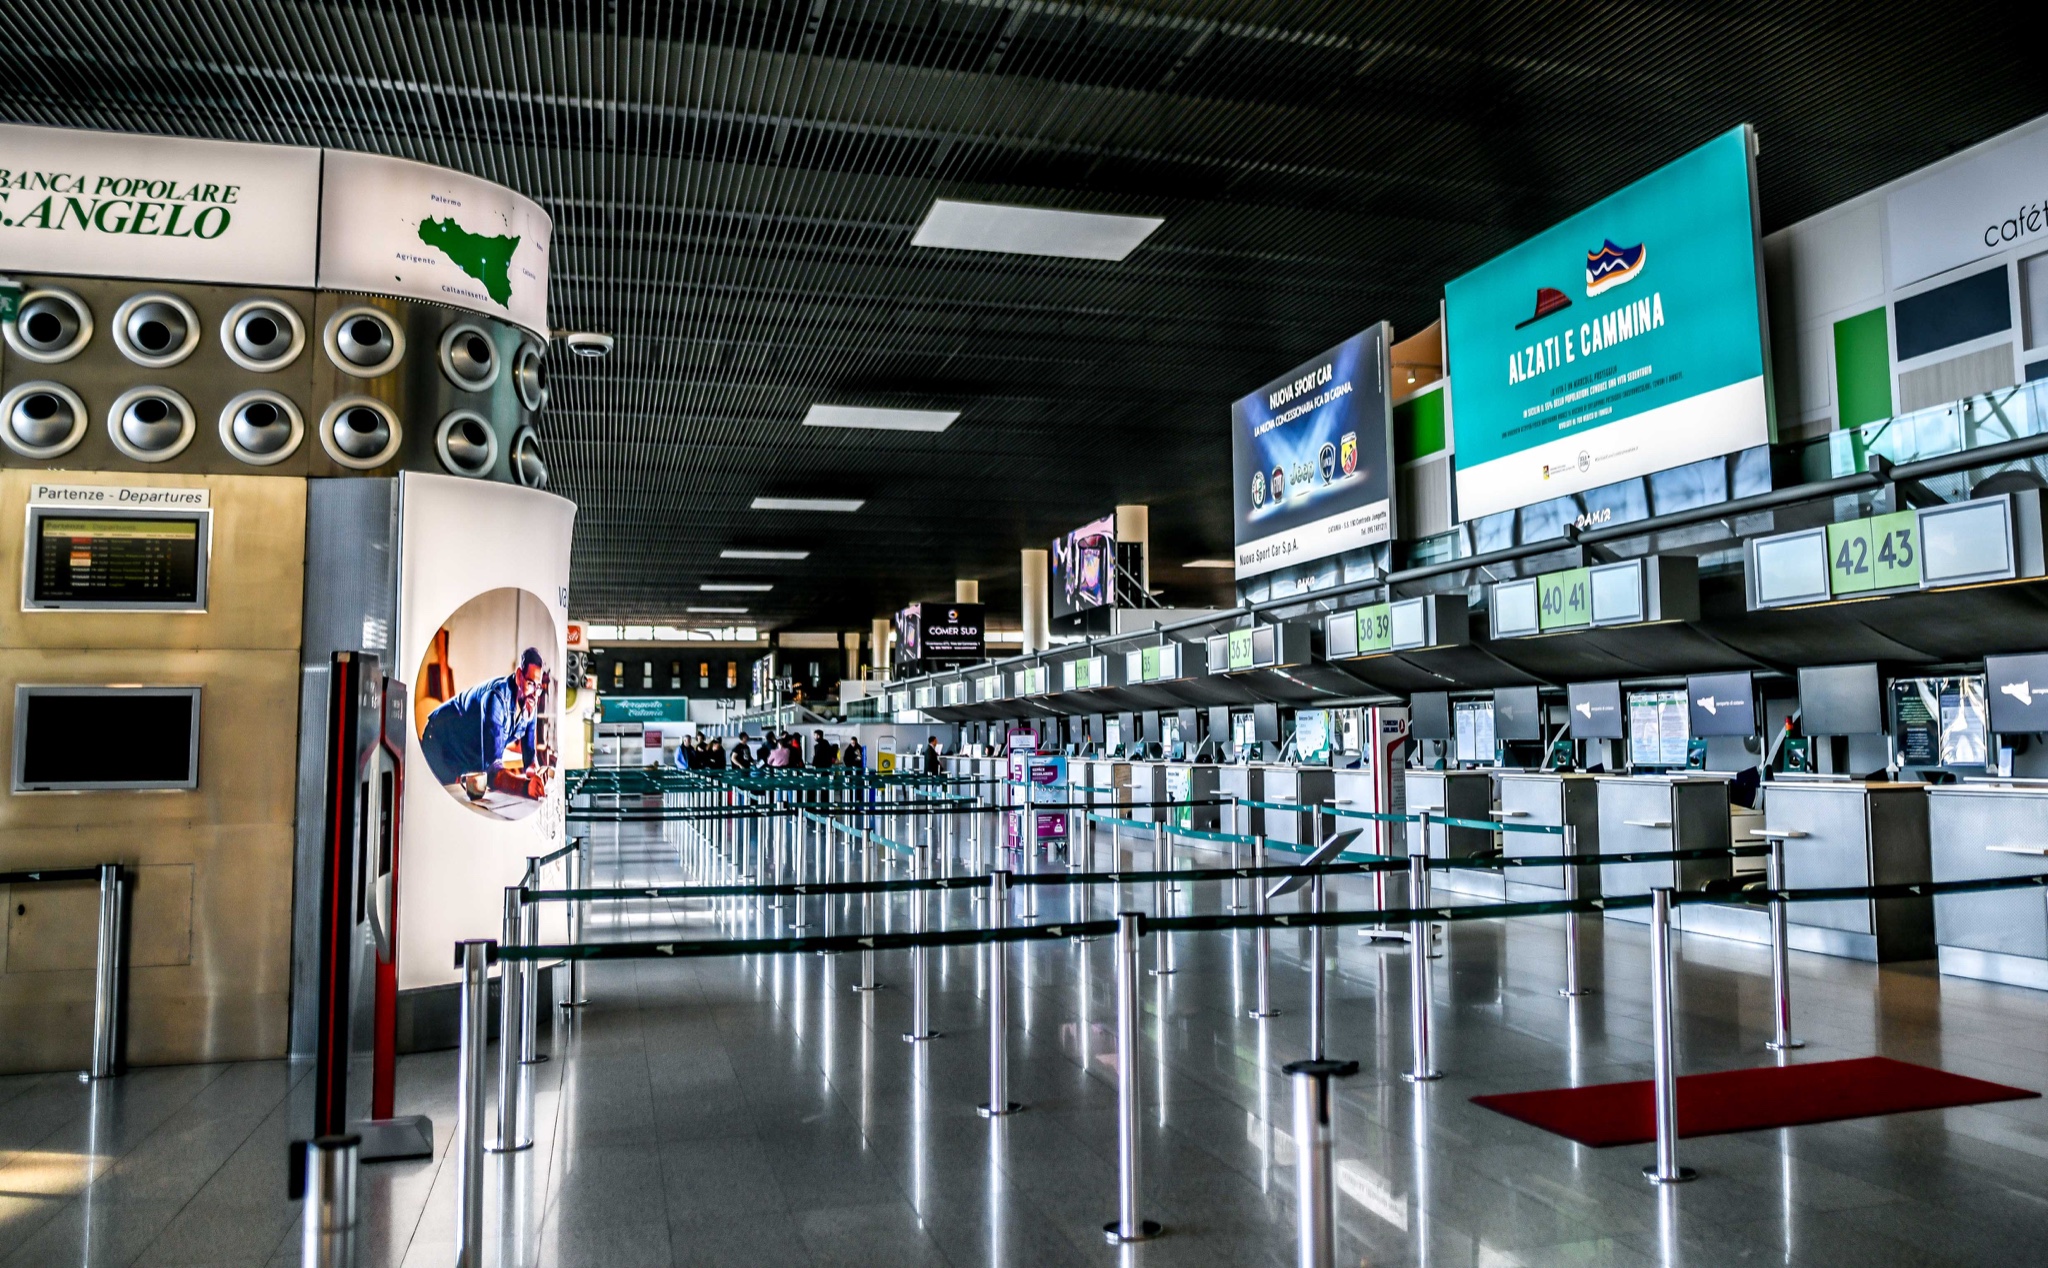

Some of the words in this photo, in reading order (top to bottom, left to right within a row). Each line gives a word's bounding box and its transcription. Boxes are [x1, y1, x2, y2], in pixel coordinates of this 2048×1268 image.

[94, 176, 240, 204] POPOLARE
[430, 194, 461, 207] Palermo
[396, 253, 435, 265] Agrigento
[441, 285, 488, 301] Caltanissetta
[1509, 335, 1560, 385] ALZATI
[1565, 329, 1575, 363] E
[1580, 292, 1664, 356] CAMMINA
[1270, 384, 1294, 410] NUOVA
[1294, 371, 1316, 397] SPORT
[1317, 364, 1332, 386] CAR
[1260, 419, 1275, 435] NUOVA
[1289, 461, 1314, 485] Jeep
[38, 487, 104, 500] Partenze
[119, 489, 202, 504] Departures
[1240, 551, 1255, 566] Nuova
[1255, 547, 1270, 564] Sport
[1271, 544, 1281, 557] Car
[1282, 538, 1299, 555] S.p.A.
[1836, 536, 1868, 576] 42
[1878, 529, 1913, 570] 43
[1542, 586, 1562, 615] 40
[1569, 582, 1585, 611] 41
[929, 626, 959, 635] COMER
[960, 626, 977, 635] SUD
[1360, 617, 1373, 641] 38
[1376, 614, 1389, 639] 39
[1231, 640, 1241, 659] 36
[1243, 638, 1251, 658] 37
[616, 700, 662, 709] Aeroporto
[628, 709, 663, 717] Catania
